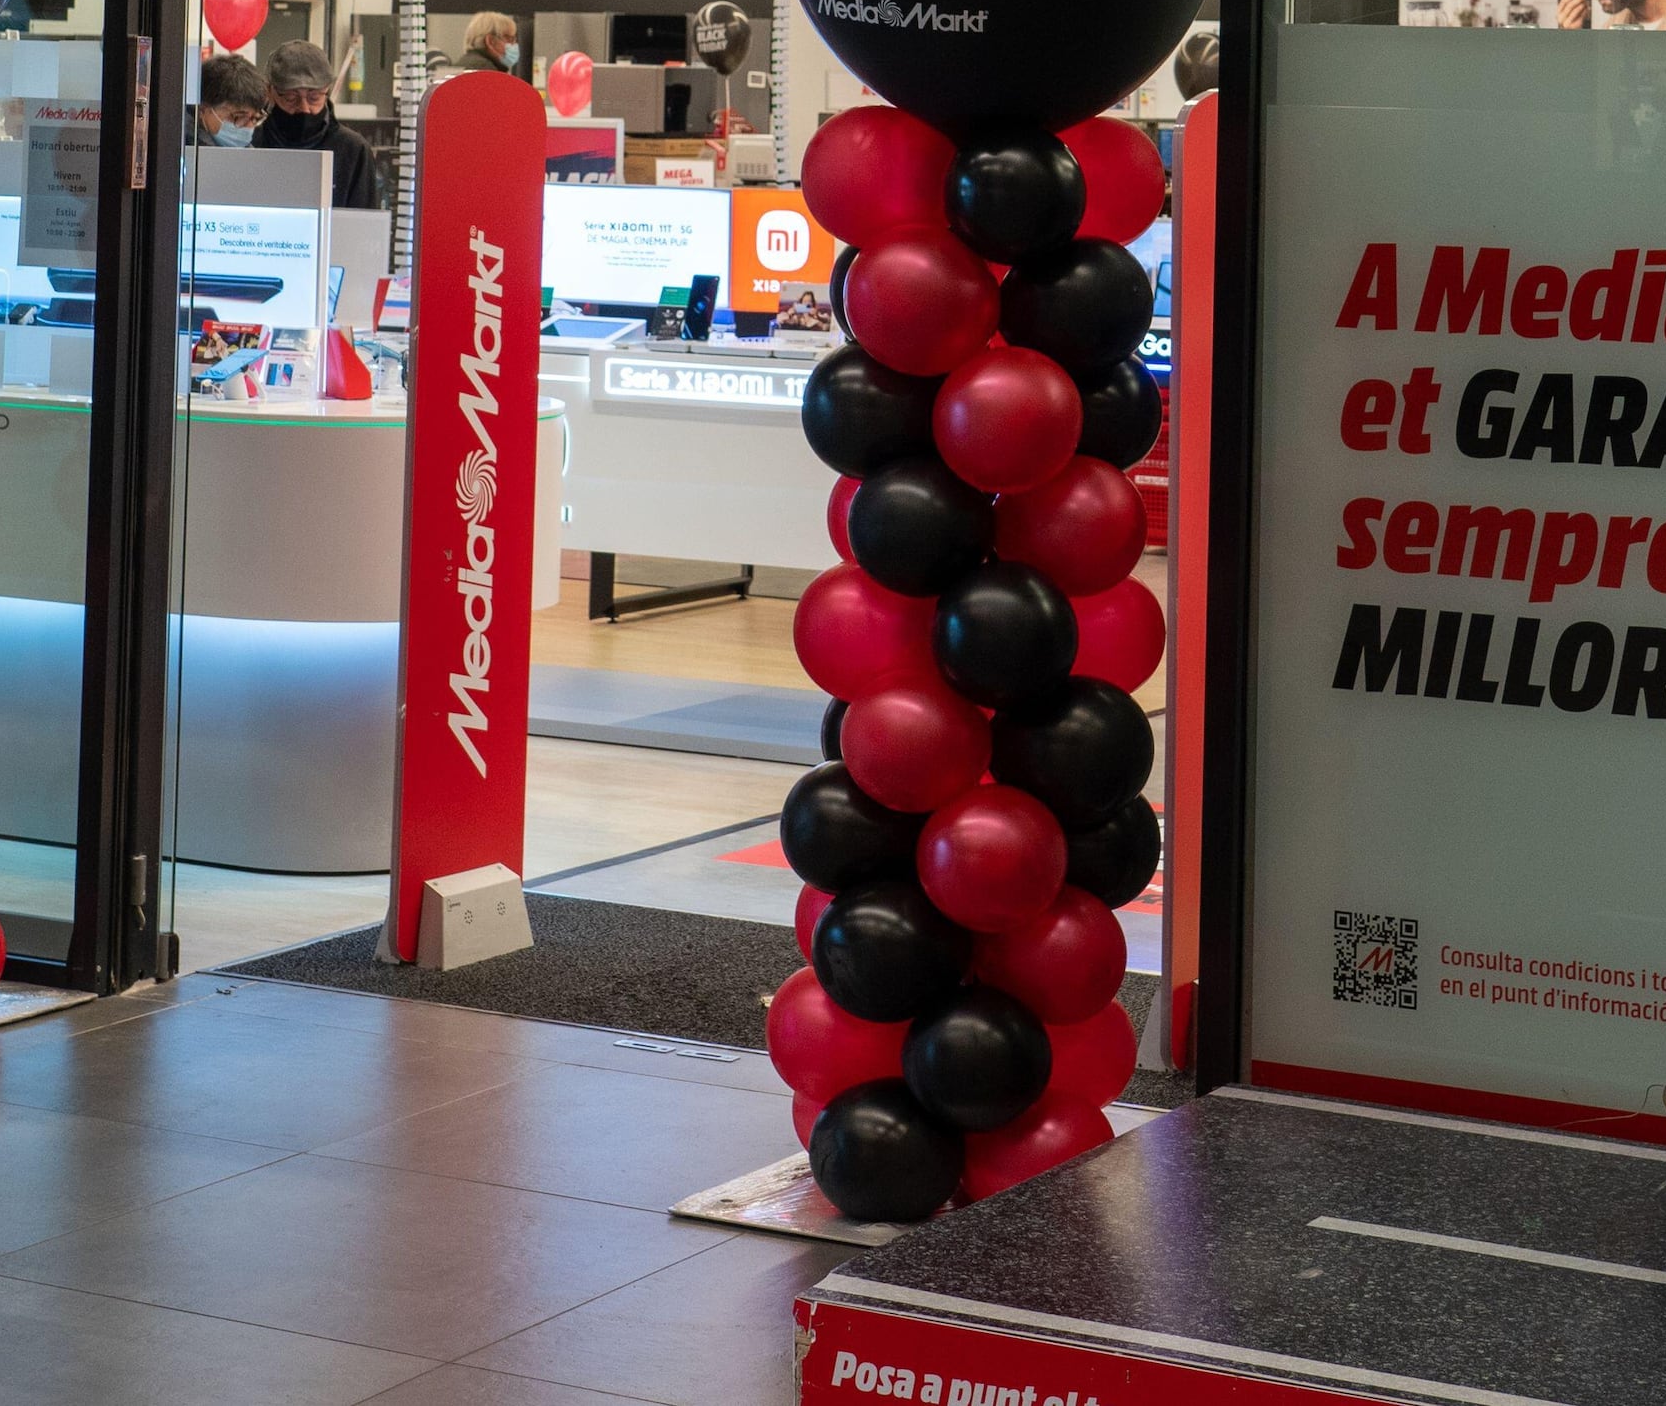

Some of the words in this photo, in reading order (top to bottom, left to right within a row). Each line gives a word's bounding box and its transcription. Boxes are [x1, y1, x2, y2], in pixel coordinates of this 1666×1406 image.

[32, 141, 61, 153] Horari
[63, 141, 101, 154] obertur
[53, 171, 81, 182] Hivern
[664, 169, 693, 179] MEGA
[56, 208, 77, 218] Estiu
[181, 220, 201, 232] Find
[204, 221, 217, 232] X3
[219, 222, 244, 234] Series
[659, 224, 672, 233] 11T
[680, 225, 693, 234] 5G
[219, 237, 256, 248] Descobreix
[264, 239, 293, 250] veritable
[293, 241, 310, 250] color
[587, 235, 599, 244] DE
[634, 235, 668, 246] CINEMA
[670, 237, 688, 247] PUR
[1336, 242, 1399, 332] A
[1139, 332, 1172, 357] Ga
[1340, 367, 1441, 455] et
[1440, 945, 1524, 974] Consulta
[1529, 955, 1636, 988] condicions
[1641, 969, 1647, 989] i
[1439, 975, 1464, 994] en
[1469, 980, 1486, 999] el
[1491, 982, 1538, 1006] punt
[832, 1351, 916, 1400] Posa
[920, 1373, 943, 1405] a
[947, 1378, 1037, 1406] punt
